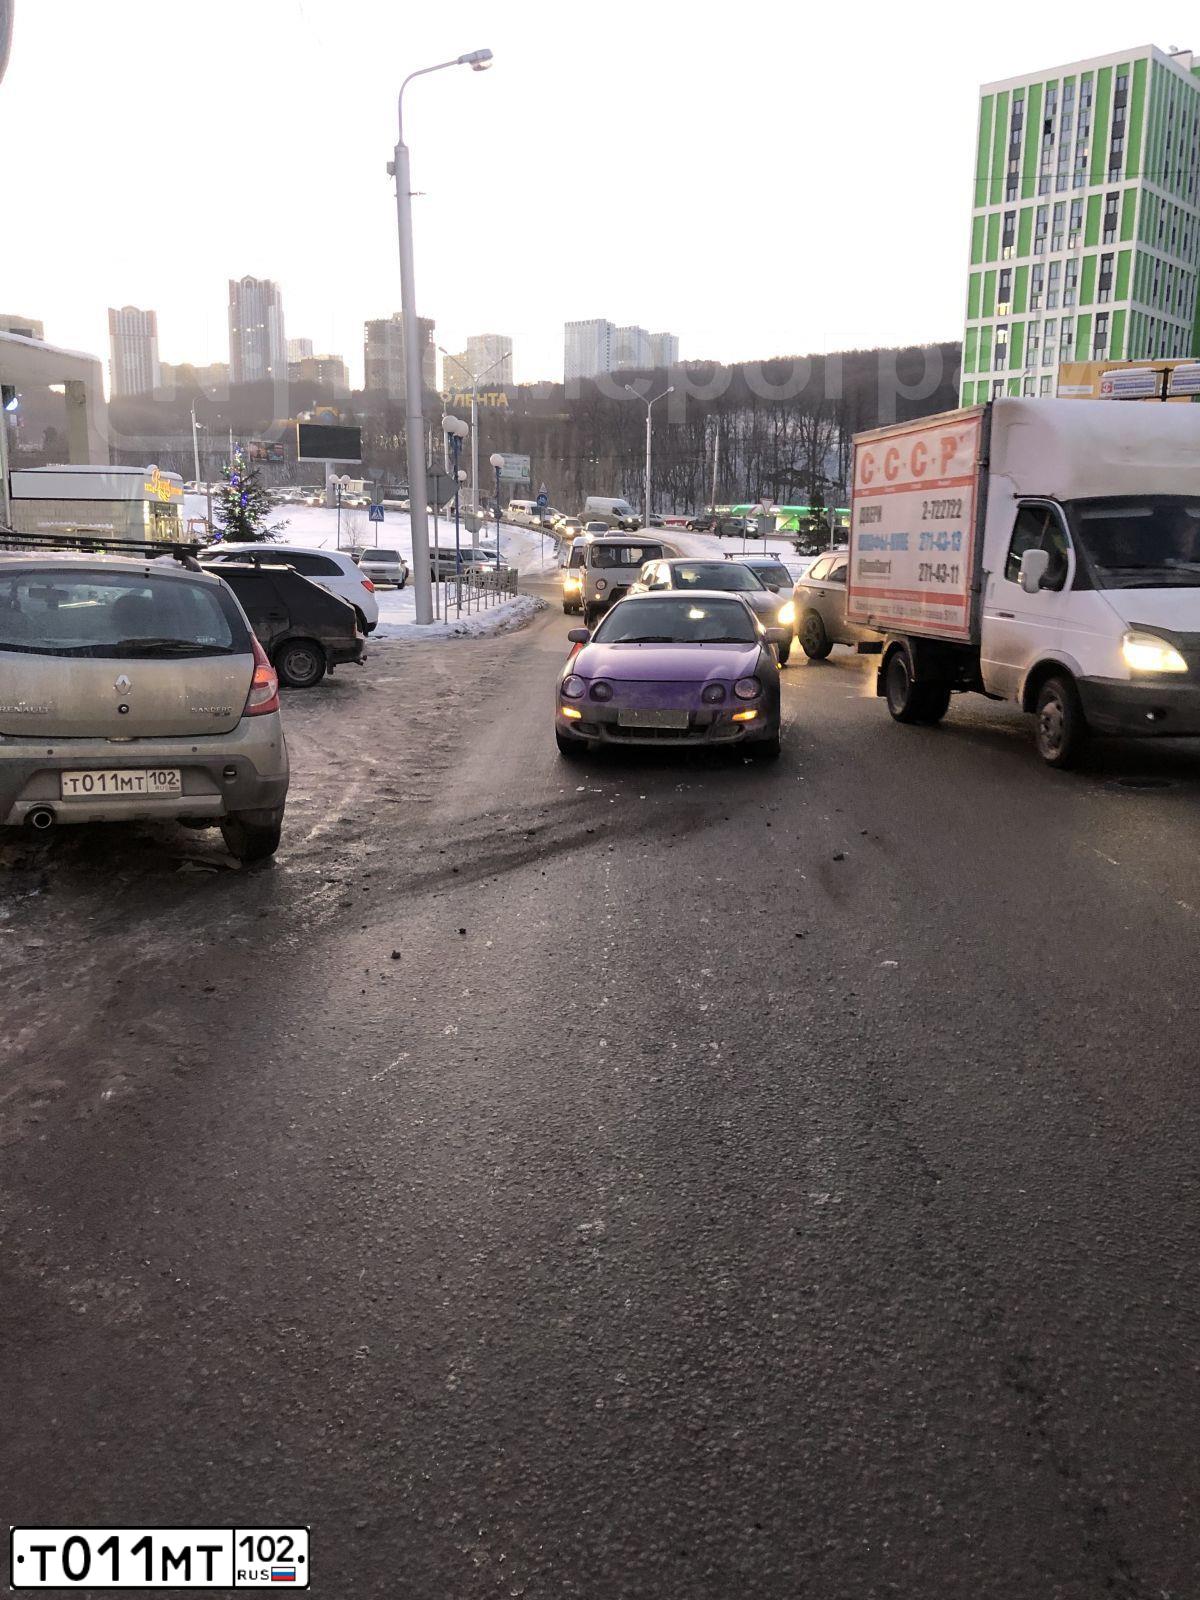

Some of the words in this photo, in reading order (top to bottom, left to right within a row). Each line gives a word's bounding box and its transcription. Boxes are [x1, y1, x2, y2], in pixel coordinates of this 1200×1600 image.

[453, 392, 509, 408] ЛЕНТА
[919, 562, 960, 584] 271-43-11
[0, 705, 49, 714] RENAULT
[149, 771, 177, 785] 102
